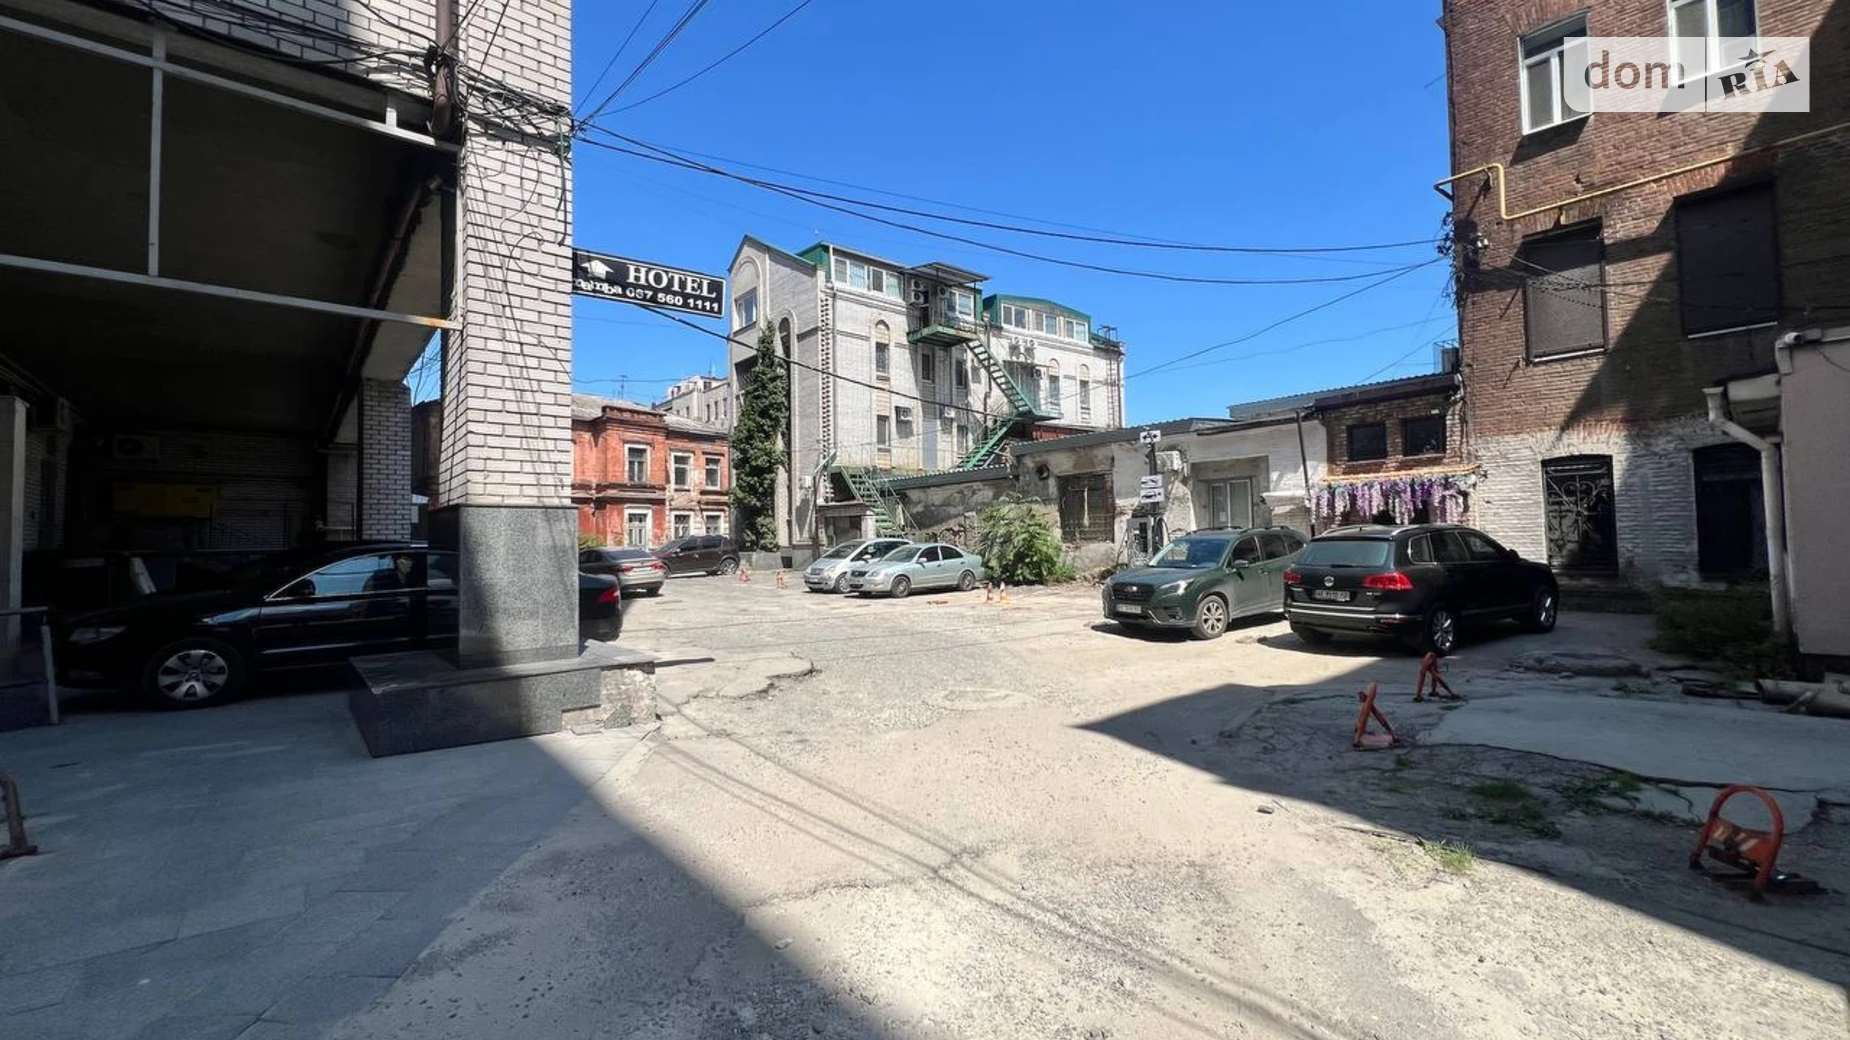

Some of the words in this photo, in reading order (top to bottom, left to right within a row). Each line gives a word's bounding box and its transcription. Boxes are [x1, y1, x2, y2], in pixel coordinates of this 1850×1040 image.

[626, 264, 717, 298] HOTEL
[657, 293, 683, 306] 560
[687, 298, 719, 312] 1111
